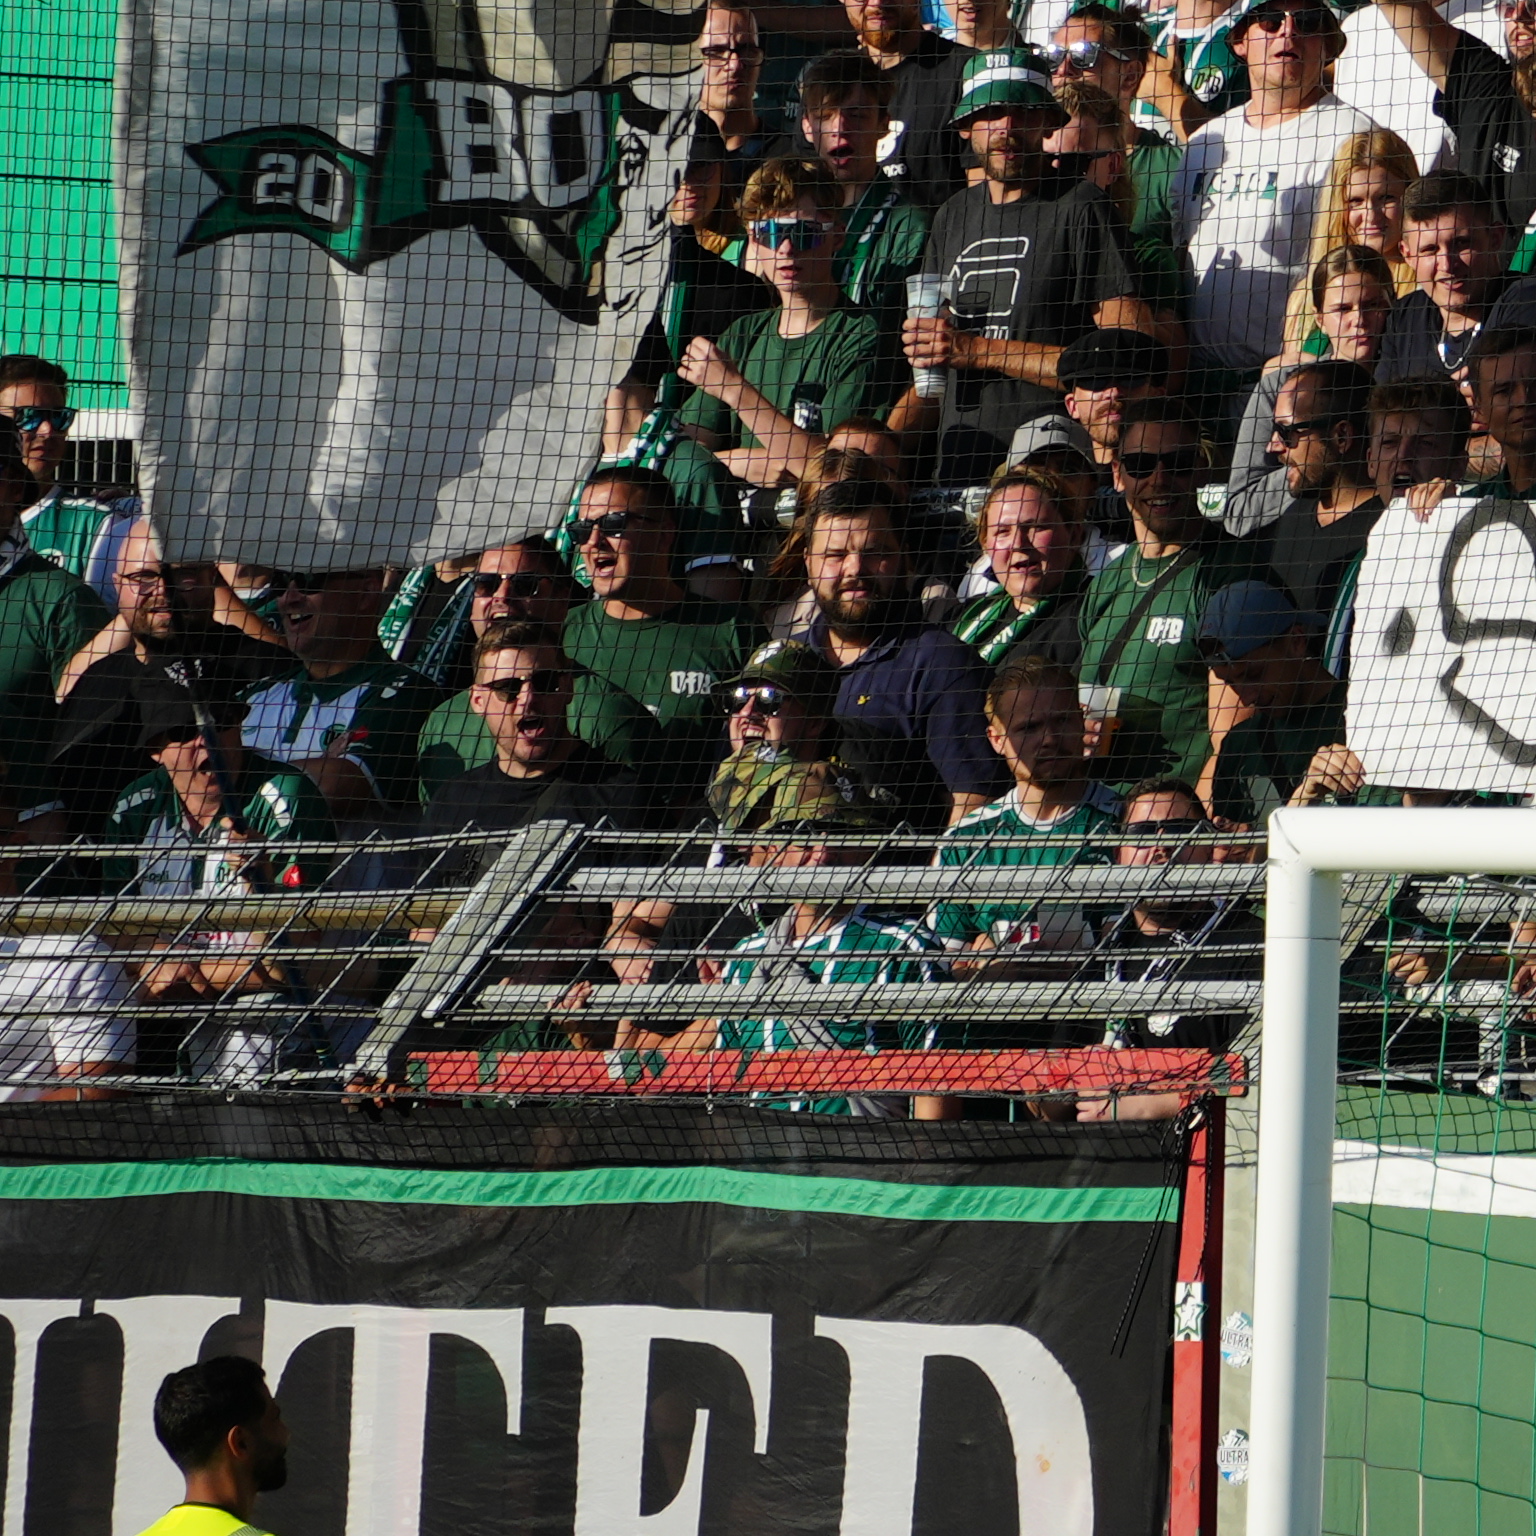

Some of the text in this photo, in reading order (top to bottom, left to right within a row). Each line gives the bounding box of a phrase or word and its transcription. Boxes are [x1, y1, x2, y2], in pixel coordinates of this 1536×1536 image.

[255, 151, 348, 234] 20
[1221, 1331, 1249, 1348] ULTRA
[0, 1296, 1096, 1536] ITED
[1220, 1448, 1249, 1464] ULTRA
